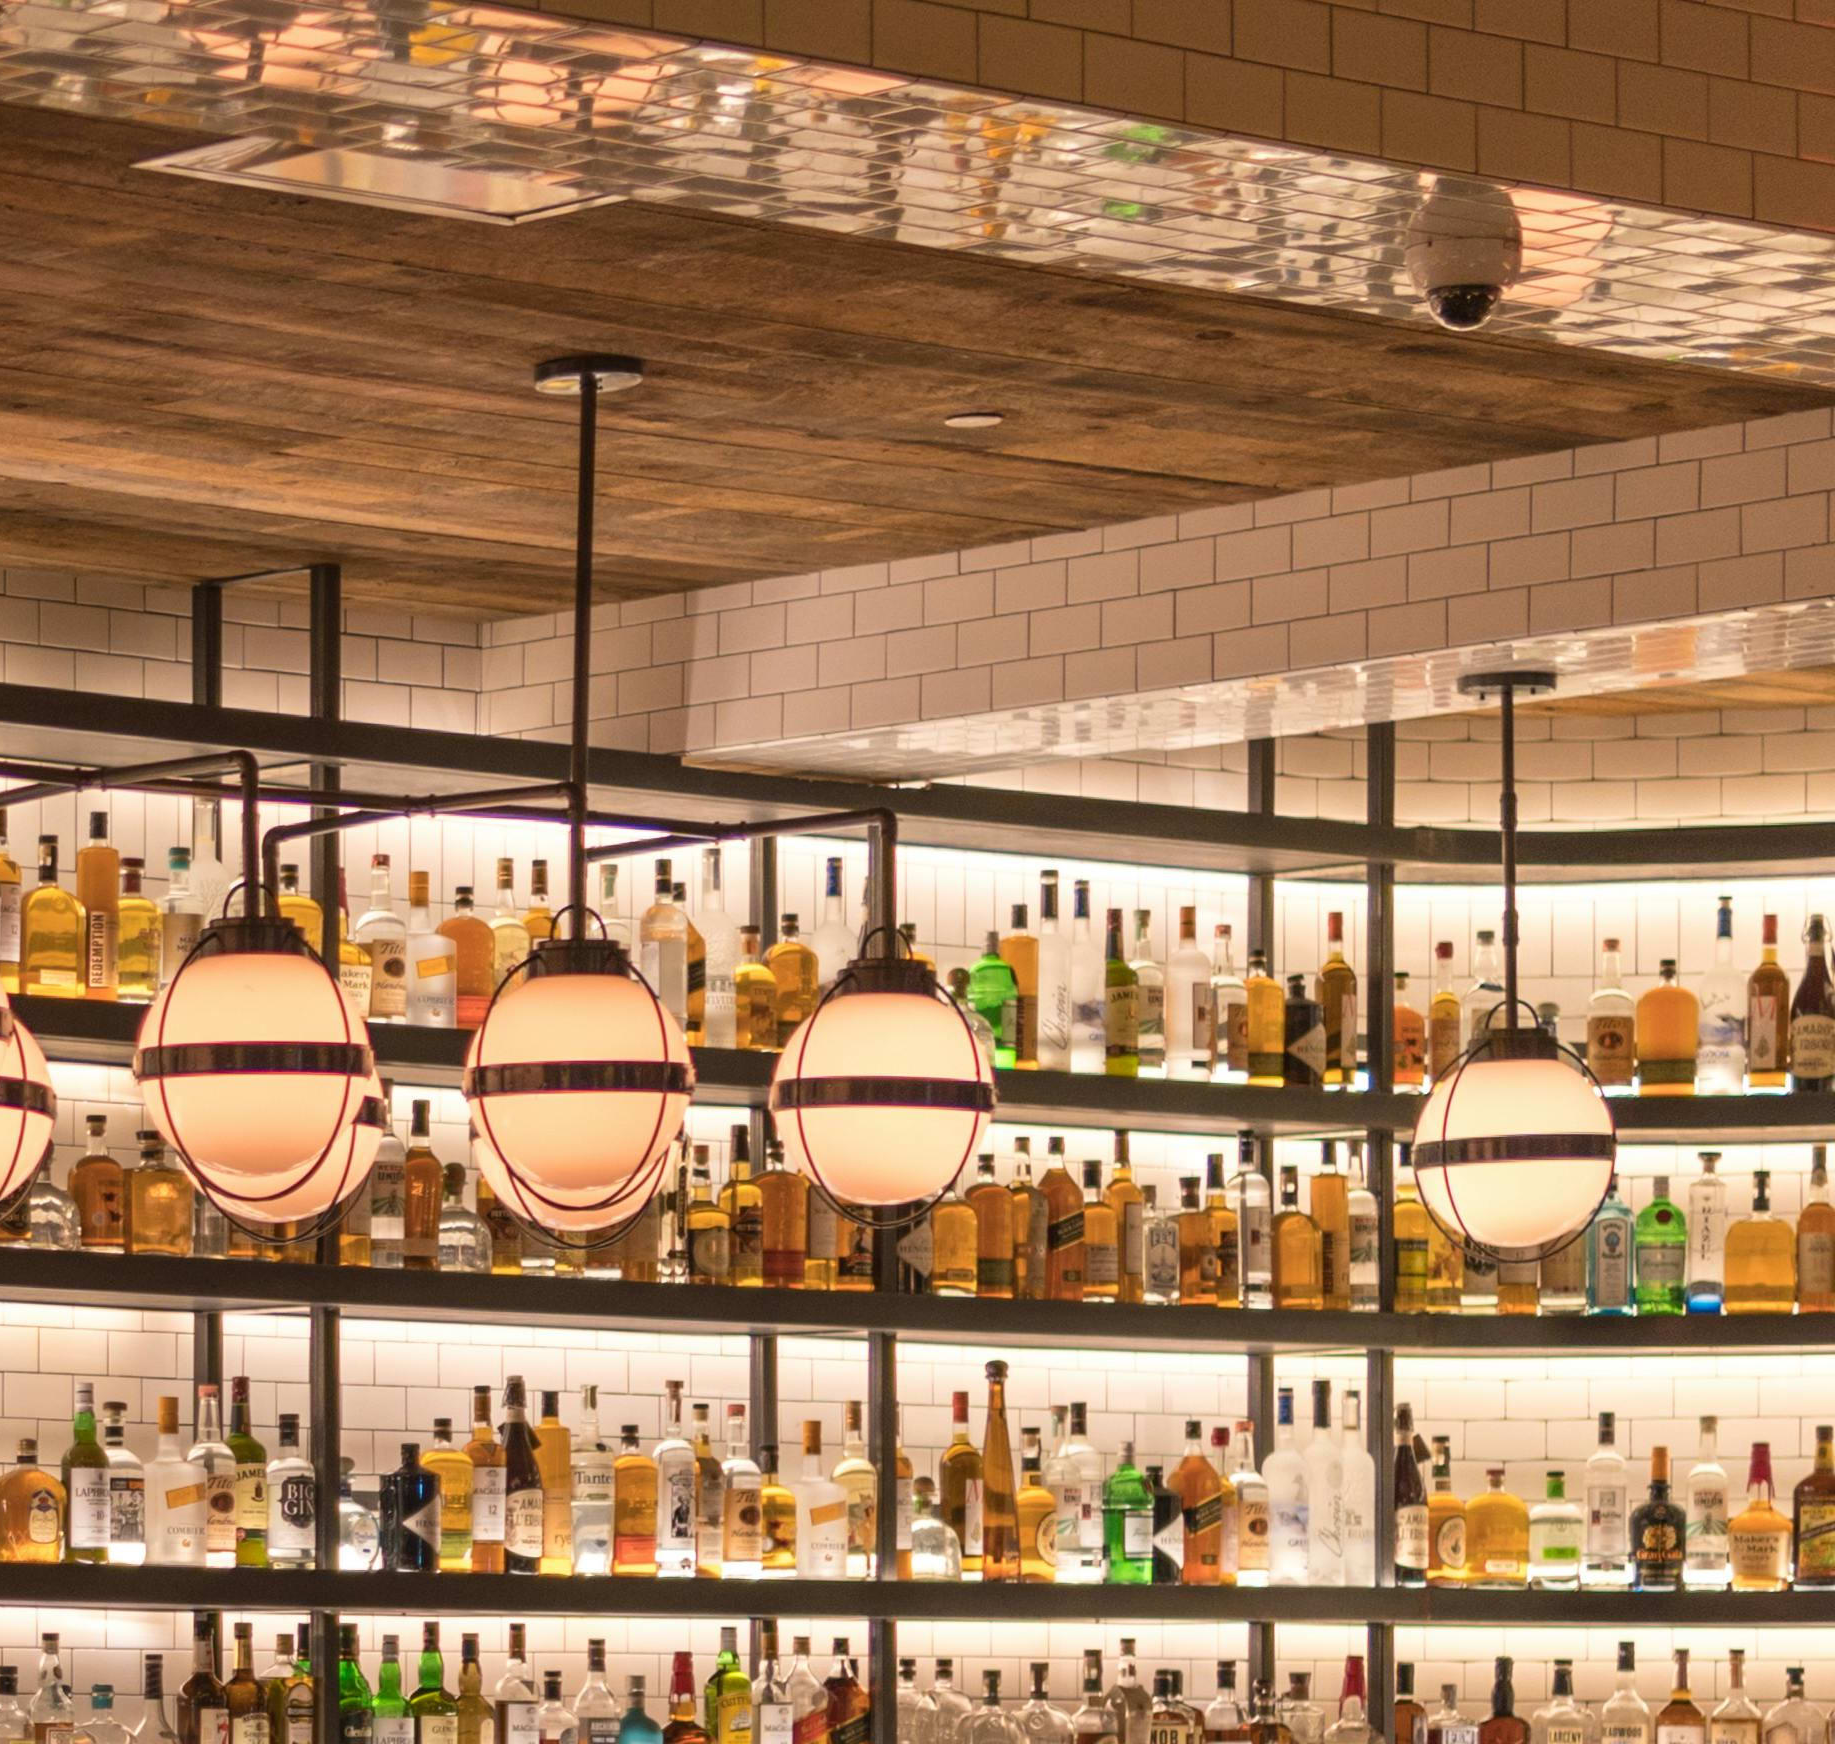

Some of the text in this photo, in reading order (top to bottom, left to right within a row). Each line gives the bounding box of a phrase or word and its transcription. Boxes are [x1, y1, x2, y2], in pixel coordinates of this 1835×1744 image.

[91, 914, 105, 984] REDEMPTION
[343, 979, 369, 990] Mark
[287, 1483, 316, 1500] BIG
[488, 1504, 497, 1516] 12
[167, 1526, 206, 1536] COMBIER
